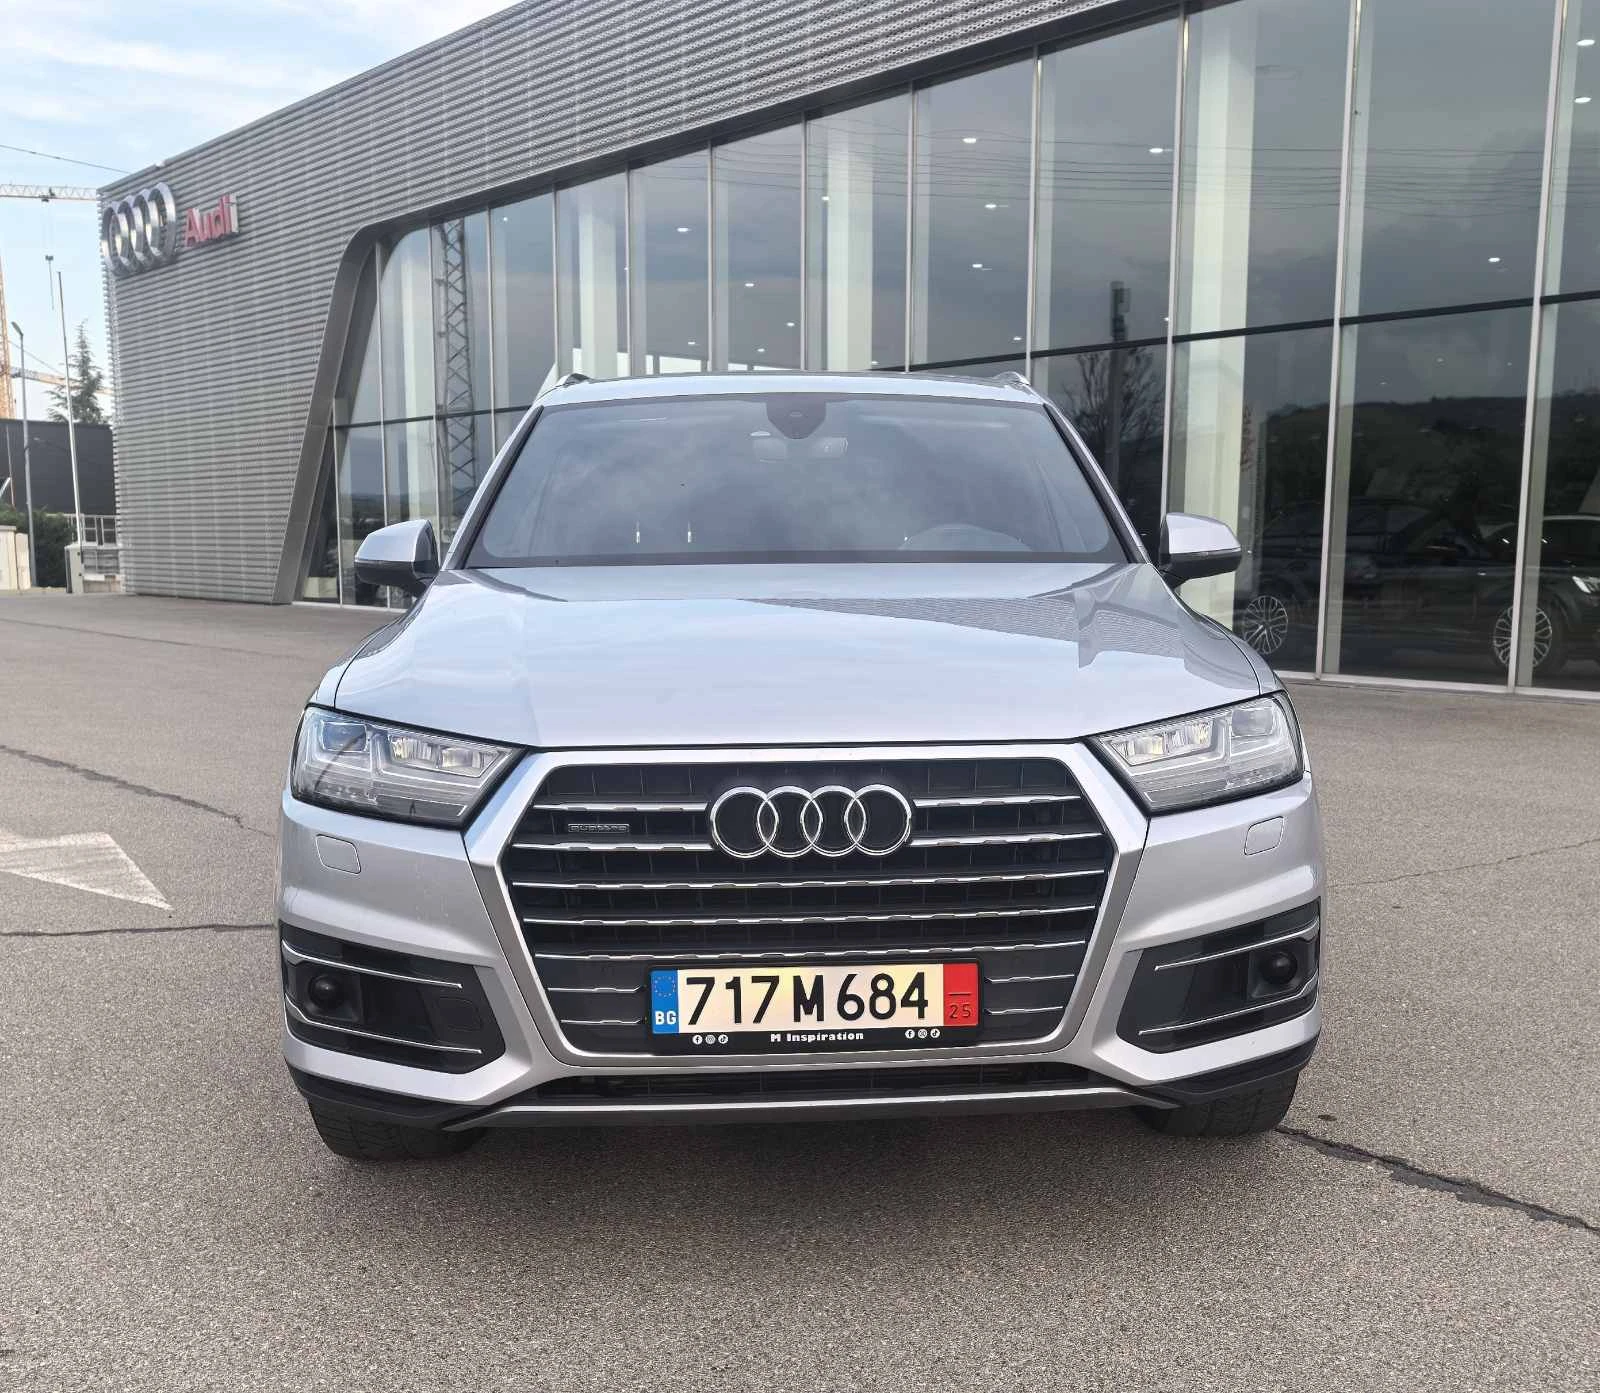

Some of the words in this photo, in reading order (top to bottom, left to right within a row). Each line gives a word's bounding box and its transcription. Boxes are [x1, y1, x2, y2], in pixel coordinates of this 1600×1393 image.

[184, 193, 238, 247] Audi
[655, 1010, 677, 1025] BG
[949, 1003, 972, 1019] 25
[770, 1033, 781, 1043] M
[786, 1031, 864, 1043] Inspiration
